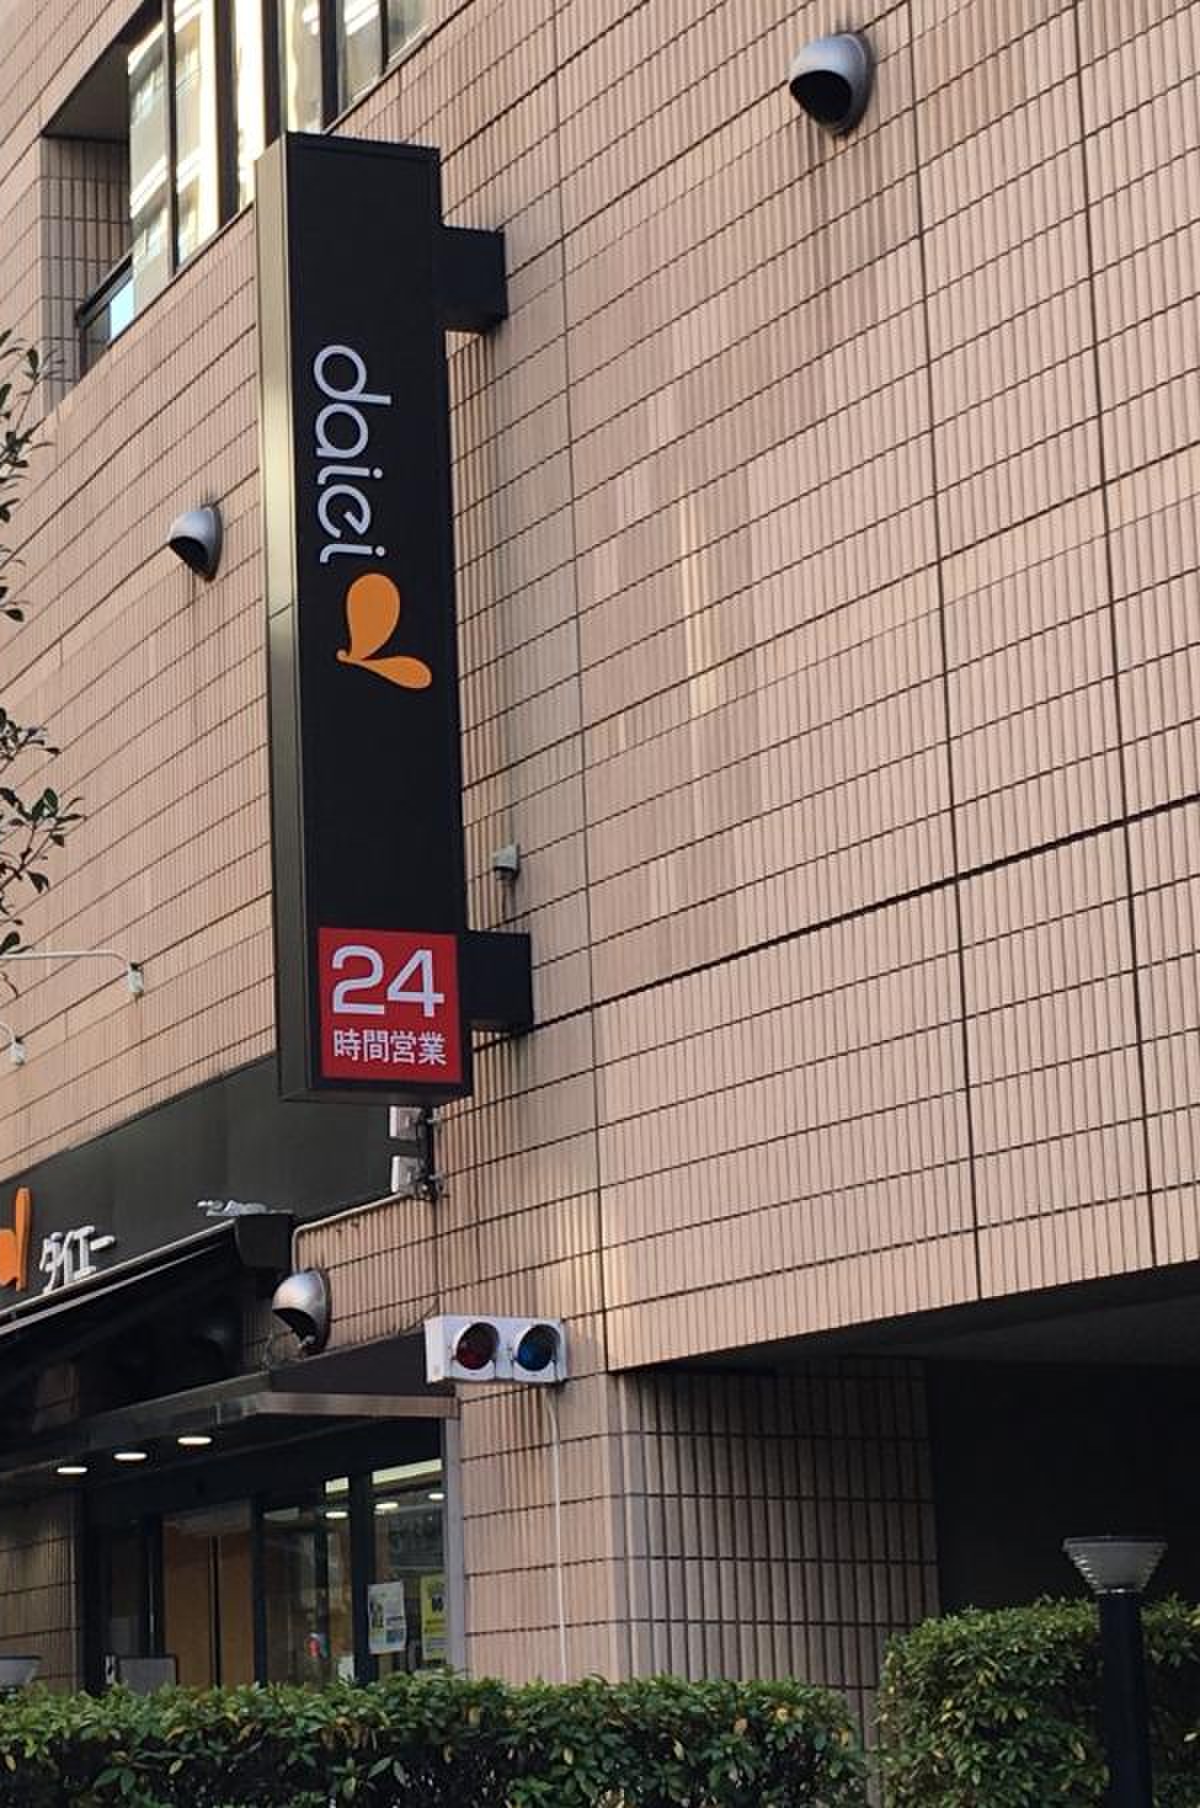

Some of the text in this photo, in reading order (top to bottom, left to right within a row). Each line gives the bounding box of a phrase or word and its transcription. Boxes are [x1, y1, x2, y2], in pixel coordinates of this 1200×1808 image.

[313, 344, 392, 564] daiei
[331, 944, 445, 1018] 24
[332, 1028, 447, 1066] 時間営業
[39, 1225, 116, 1294] ダイエー
